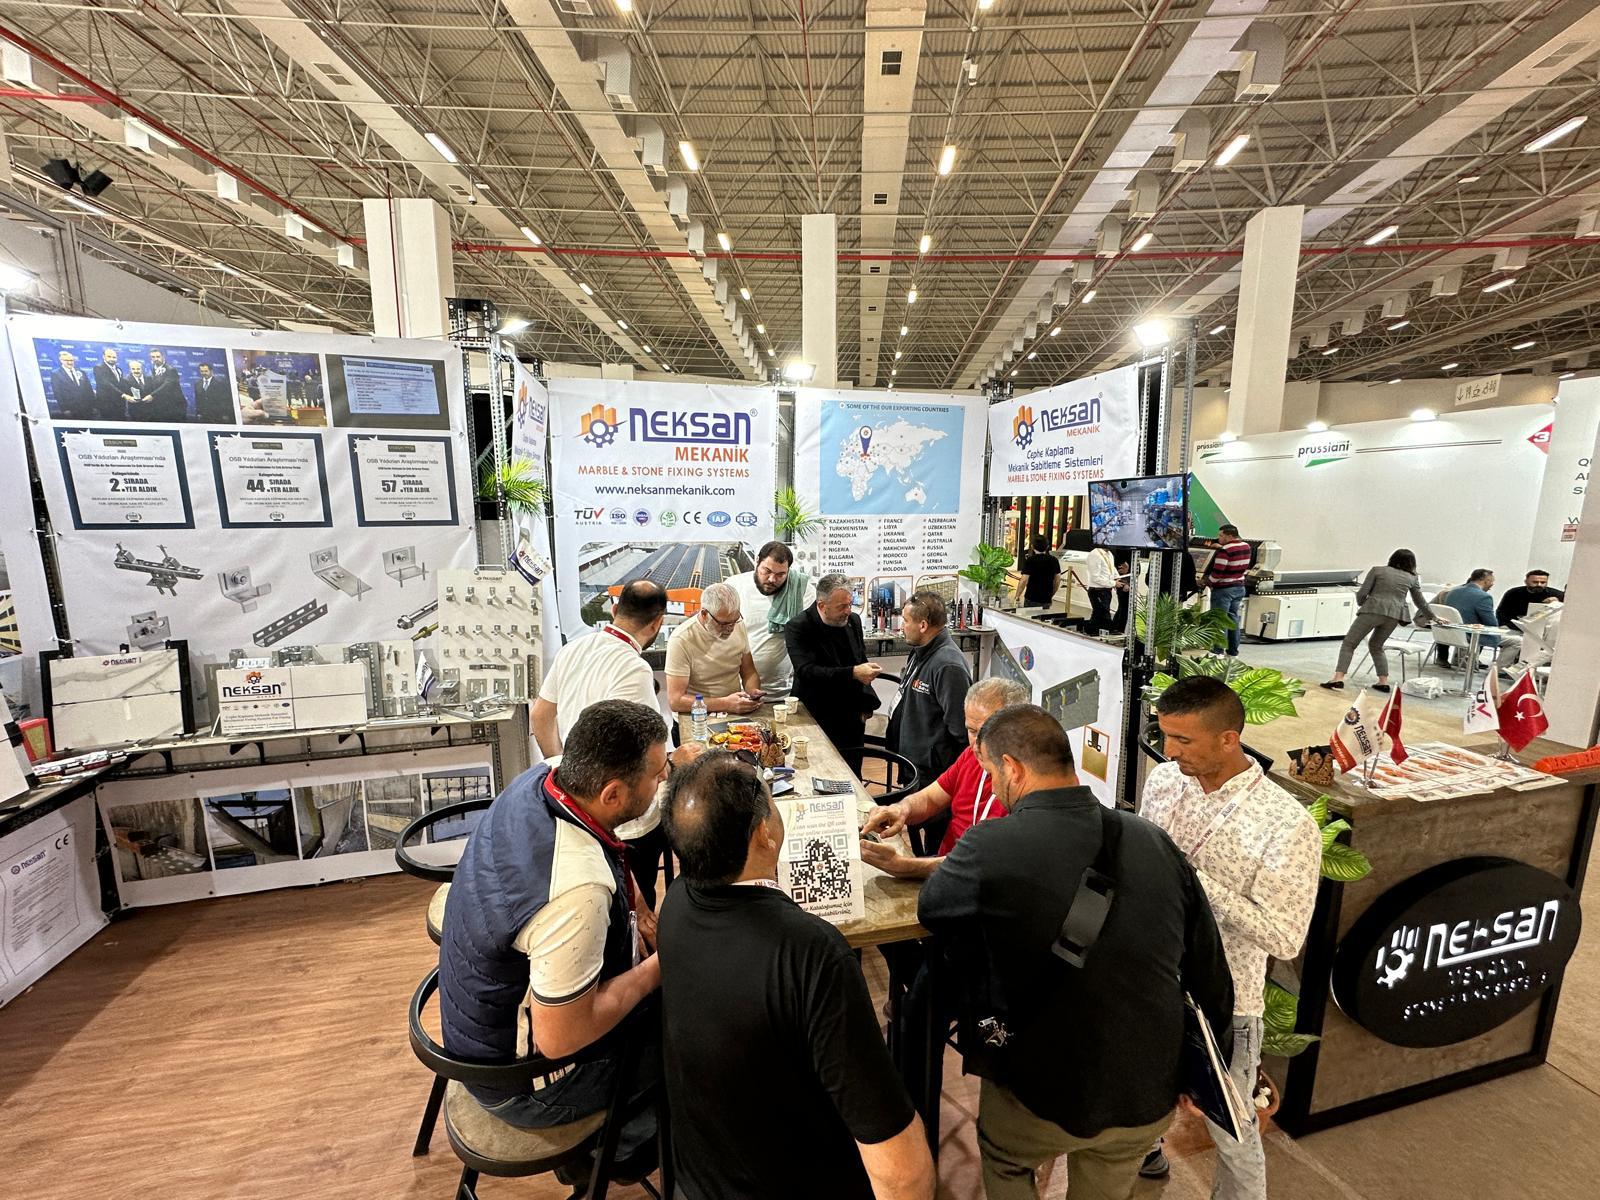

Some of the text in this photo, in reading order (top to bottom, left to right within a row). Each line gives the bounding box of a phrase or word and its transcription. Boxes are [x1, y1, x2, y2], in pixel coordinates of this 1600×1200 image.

[675, 446, 749, 462] MEKANİK
[1027, 446, 1074, 460] Cephe Kaplama
[1298, 440, 1350, 457] prussiani
[1008, 455, 1103, 472] Mekanik Sabitleme Sistemleri
[1578, 459, 1592, 467] Q
[578, 465, 749, 478] MARBLE & STONE FIXING SYSTEMS
[1049, 471, 1070, 481] FIXING
[1073, 469, 1104, 480] SYSTEMS
[109, 478, 125, 492] 2.
[247, 479, 270, 492] 44.
[382, 480, 403, 492] 57.
[595, 484, 735, 496] www.neksanmekanik.com
[684, 511, 701, 524] CE
[55, 834, 69, 850] CE
